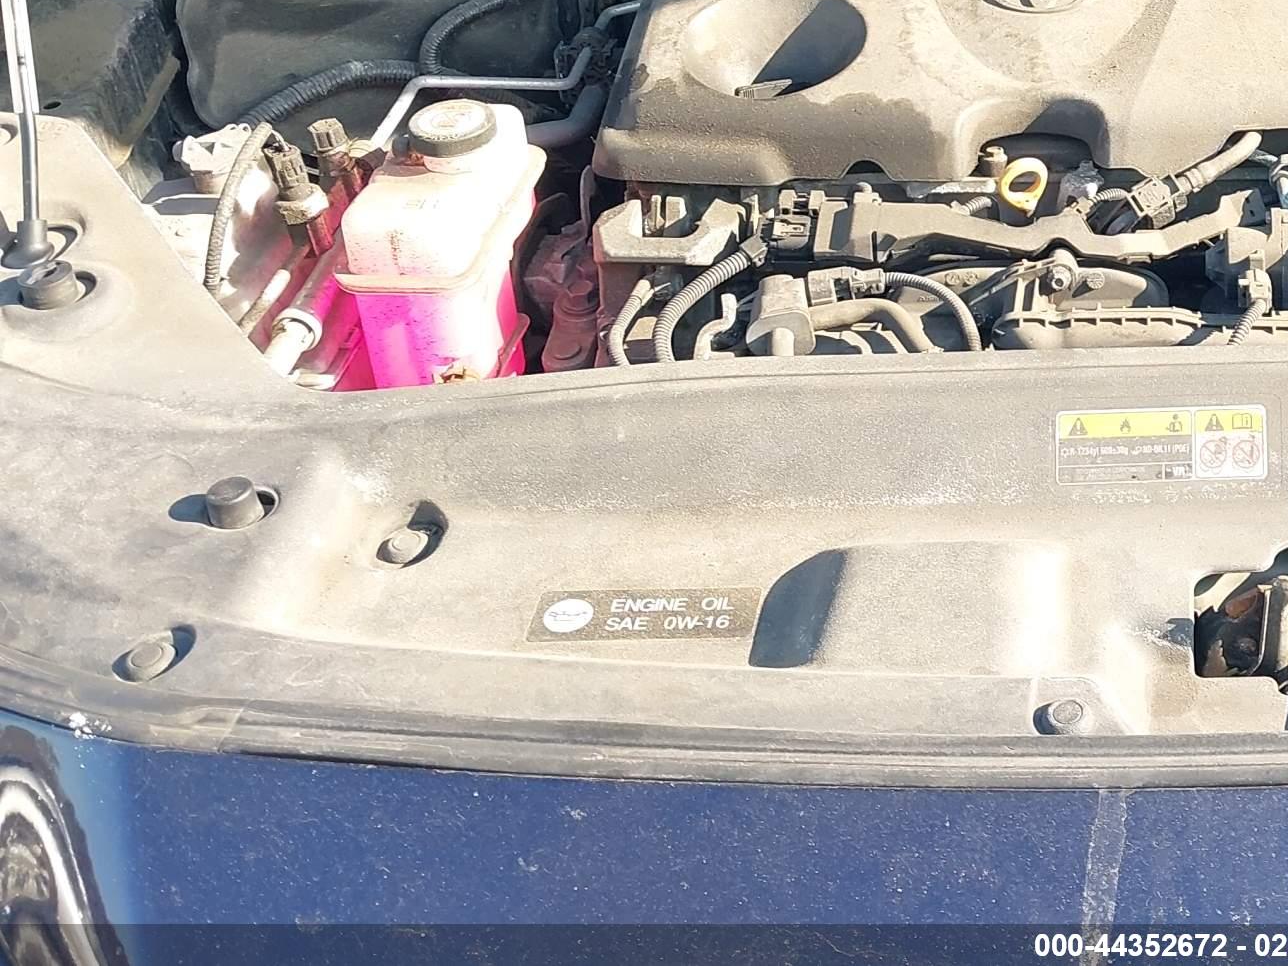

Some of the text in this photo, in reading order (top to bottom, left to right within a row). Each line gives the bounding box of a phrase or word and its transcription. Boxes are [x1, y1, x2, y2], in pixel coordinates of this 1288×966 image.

[610, 597, 734, 613] ENGINE OIL
[604, 615, 731, 632] SAE 0W-16
